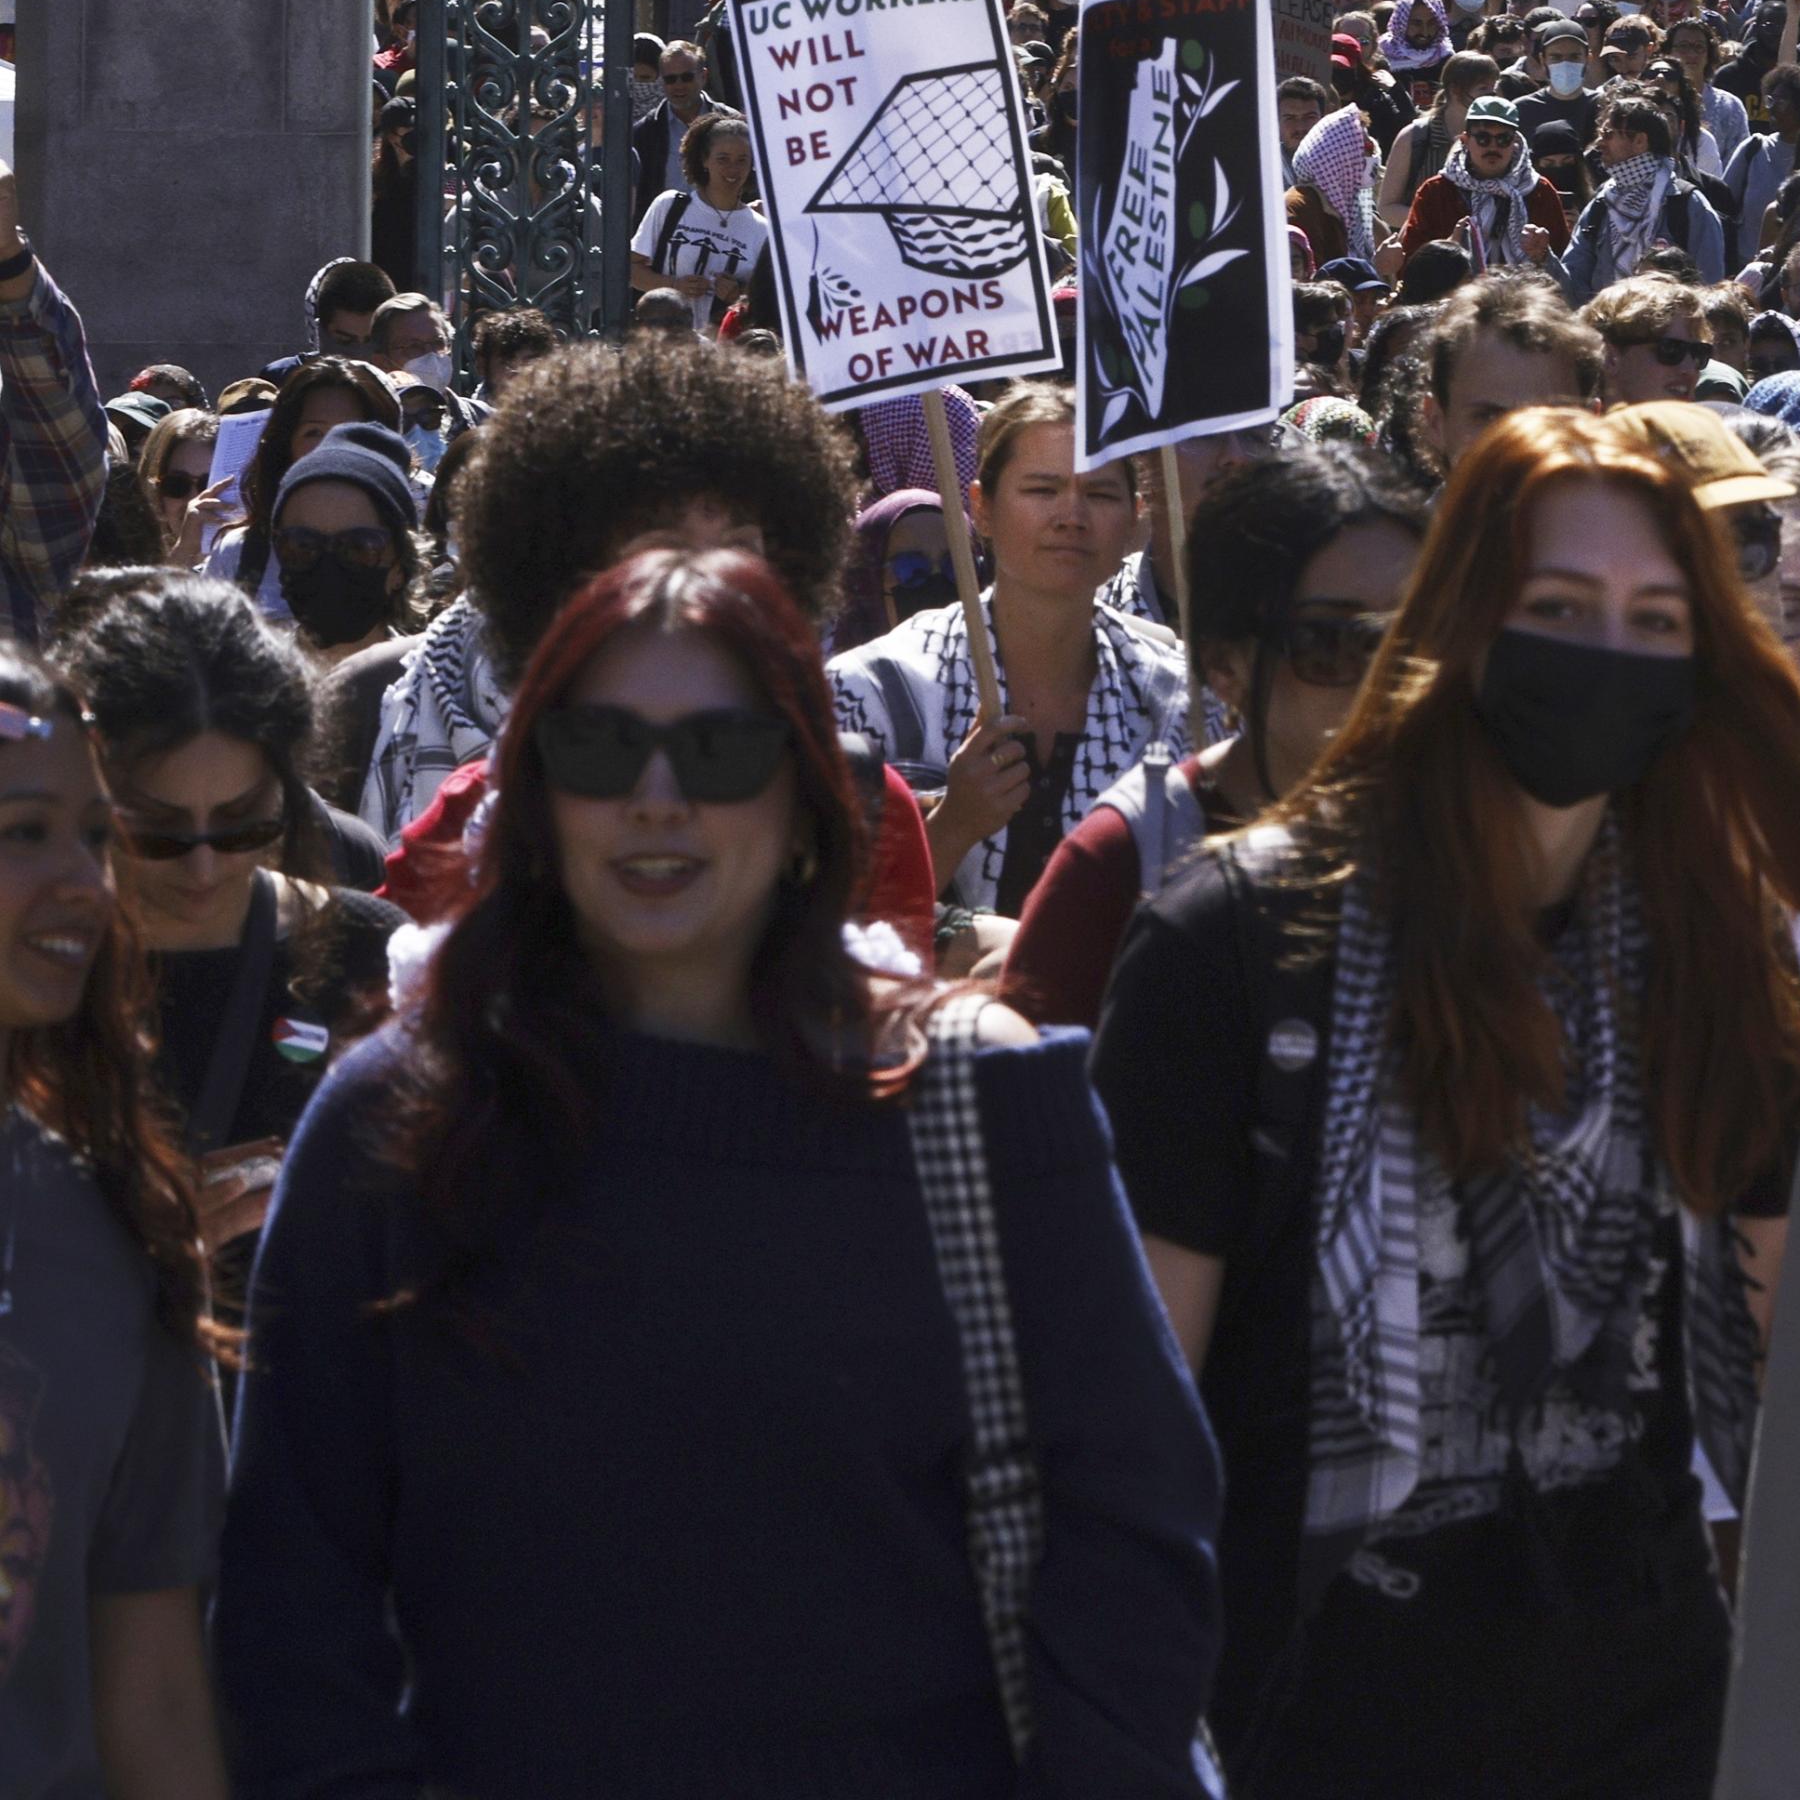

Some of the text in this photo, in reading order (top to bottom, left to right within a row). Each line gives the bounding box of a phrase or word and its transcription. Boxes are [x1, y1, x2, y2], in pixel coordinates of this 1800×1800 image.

[749, 1, 792, 35] UC
[768, 29, 865, 71] WILL
[778, 76, 857, 120] NOT
[786, 130, 831, 167] BE
[1107, 140, 1149, 299] FREE
[1124, 62, 1176, 385] PALESTINE
[814, 280, 1004, 345] WEAPONS
[848, 345, 893, 383] OF
[902, 310, 990, 366] WAR
